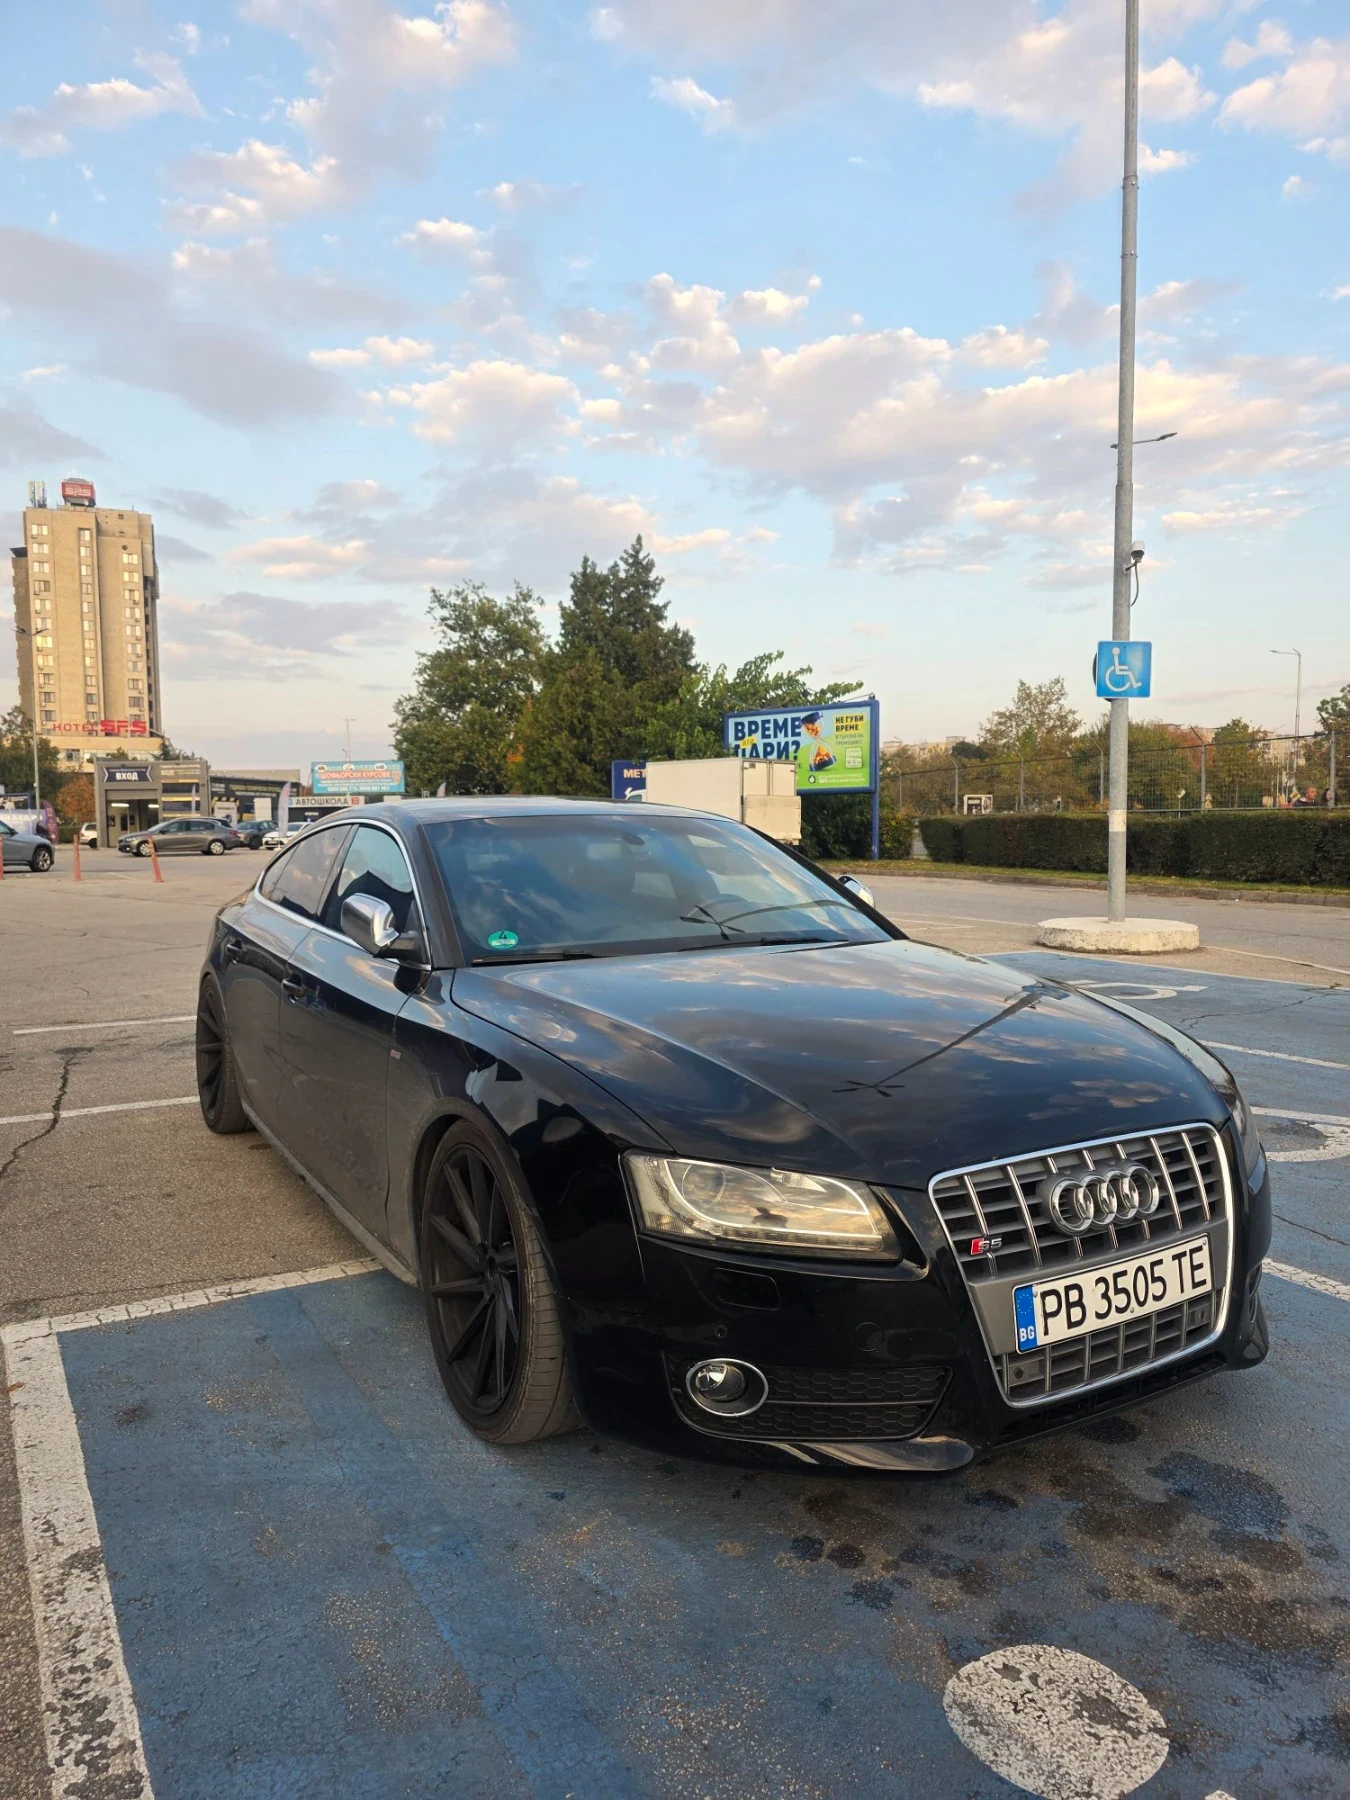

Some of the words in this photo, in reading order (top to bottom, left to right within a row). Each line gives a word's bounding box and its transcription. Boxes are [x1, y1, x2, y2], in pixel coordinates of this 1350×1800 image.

[836, 716, 844, 724] НЕ
[845, 715, 864, 723] ГУБИ
[53, 723, 96, 732] HOTEL
[734, 716, 802, 741] ВРЕМЕ
[836, 724, 859, 732] ВРЕМЕ
[115, 772, 139, 782] ВХОД
[295, 797, 349, 806] АВТОШКОЛА
[499, 931, 508, 940] 4
[977, 1237, 1003, 1251] S5
[1041, 1282, 1087, 1337] PB
[1094, 1258, 1167, 1320] 3505
[1172, 1245, 1208, 1294] TE
[1019, 1326, 1035, 1342] BG
